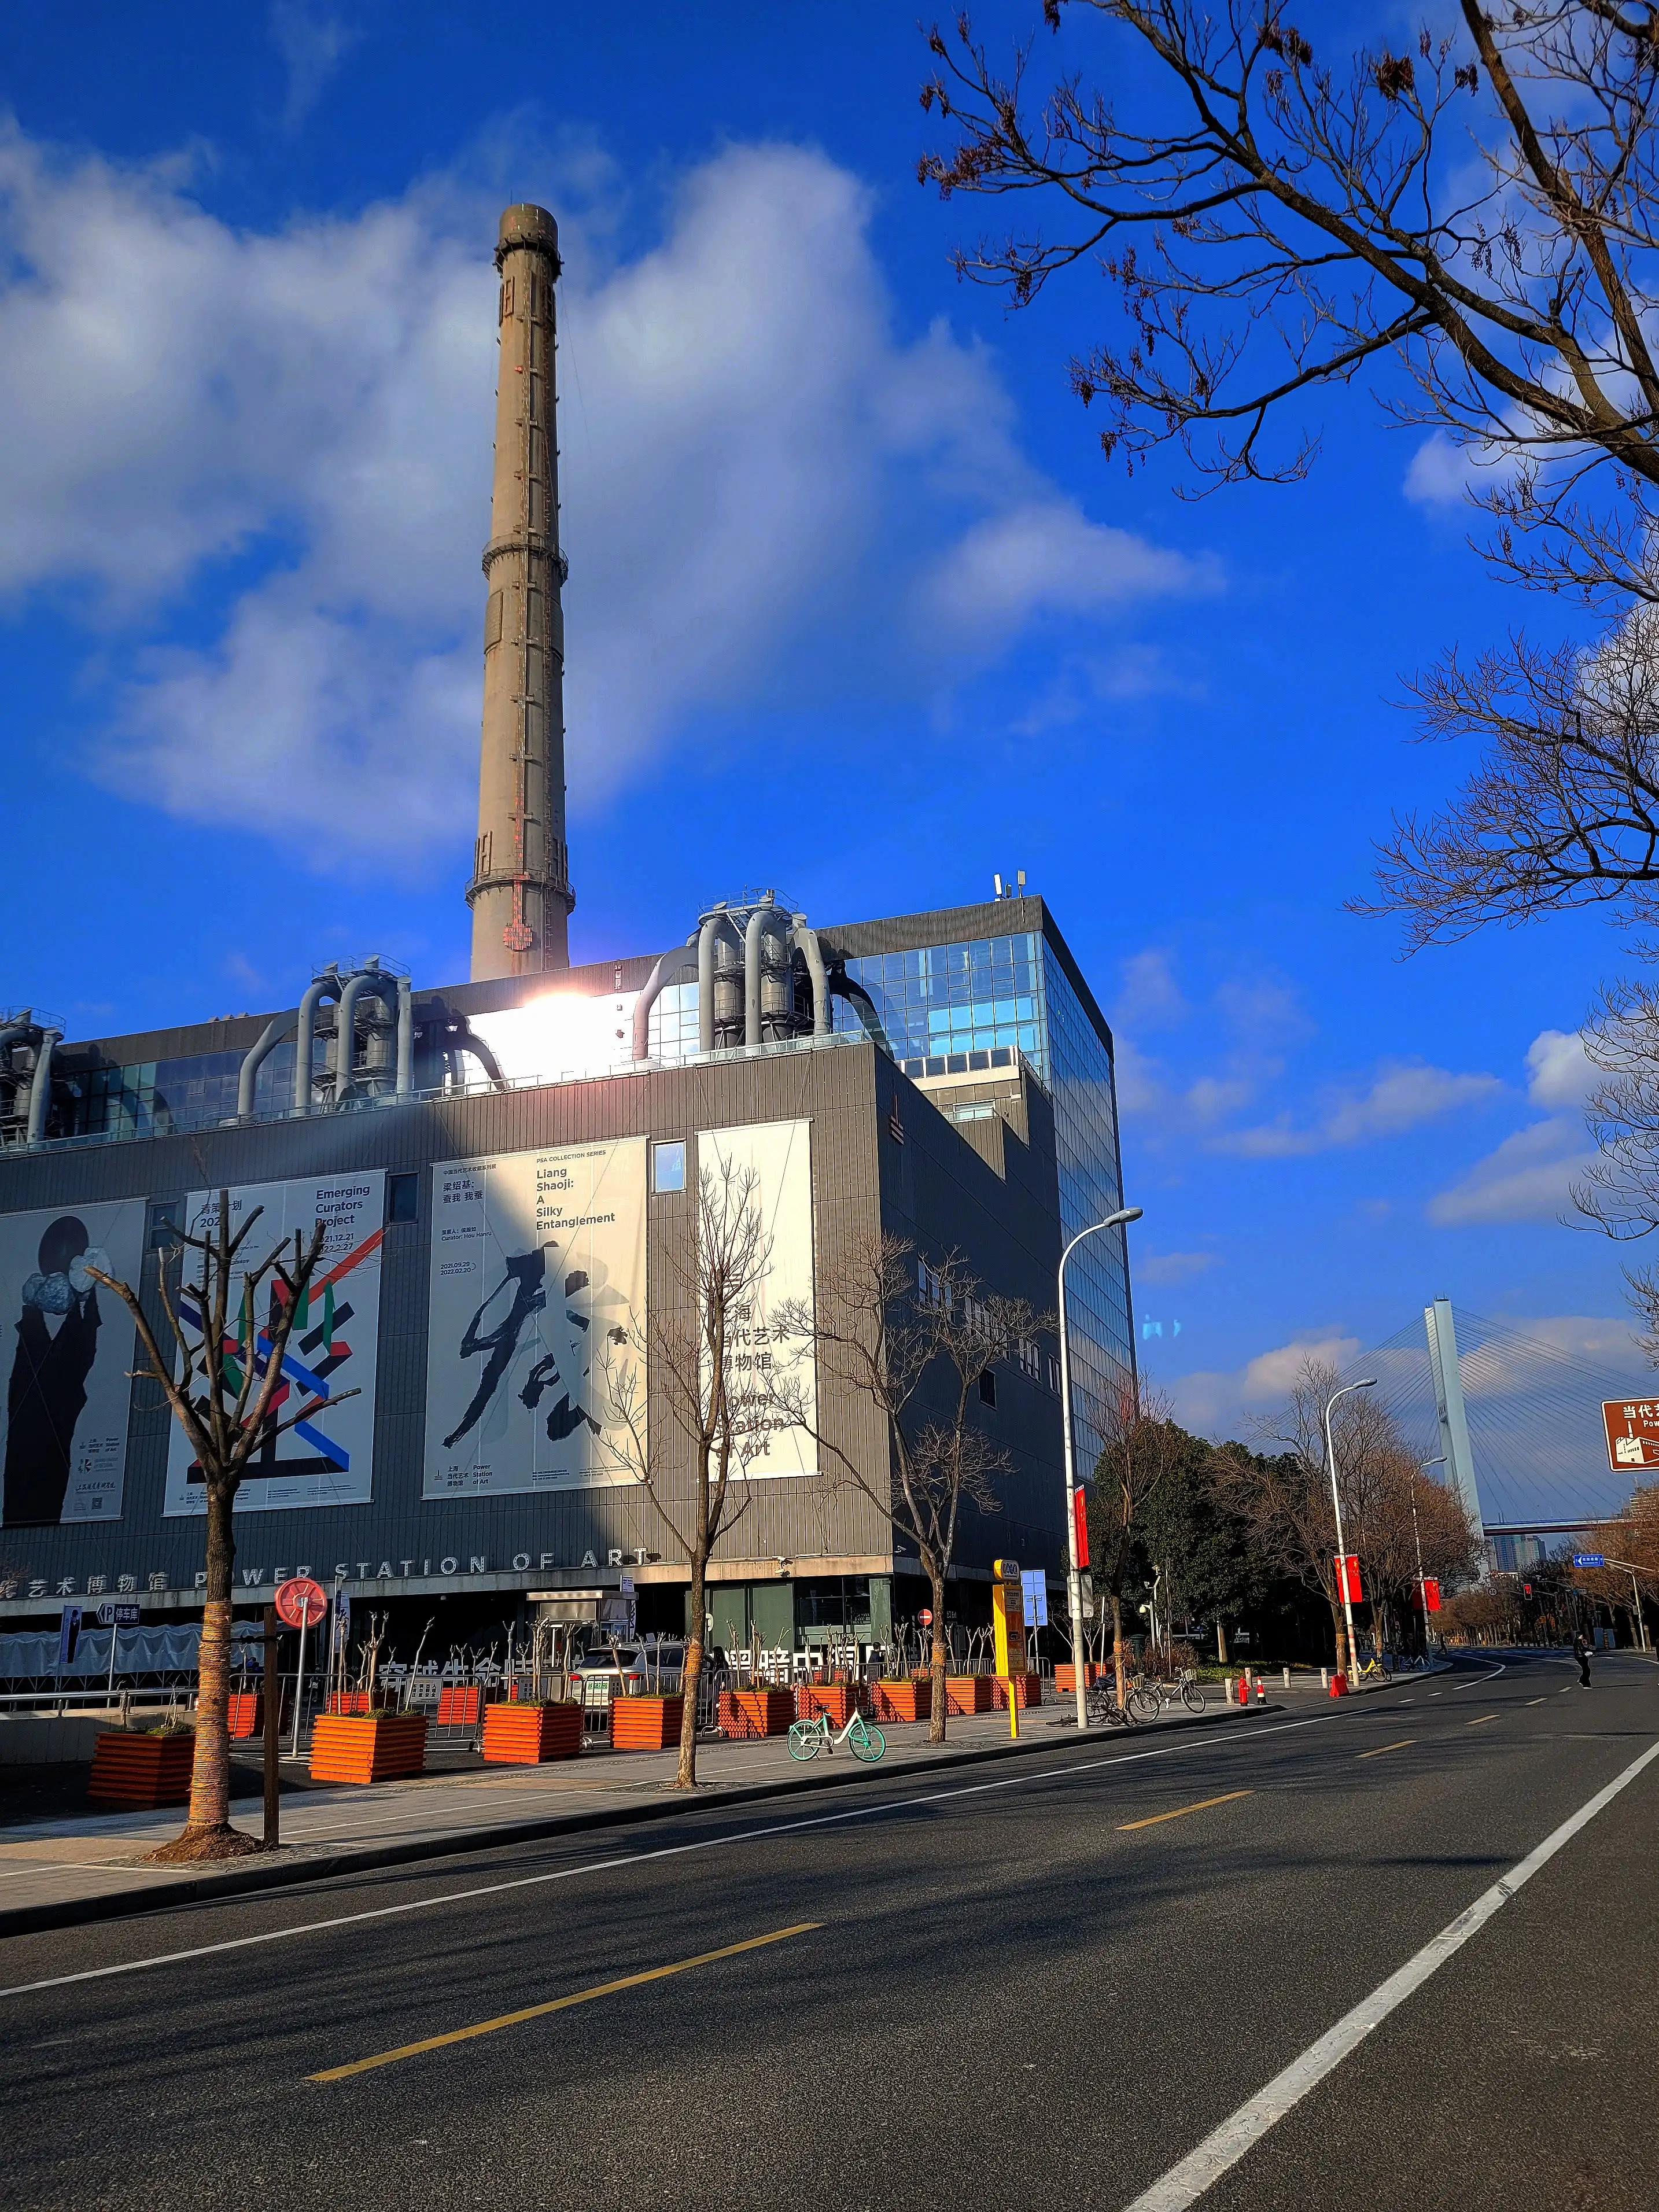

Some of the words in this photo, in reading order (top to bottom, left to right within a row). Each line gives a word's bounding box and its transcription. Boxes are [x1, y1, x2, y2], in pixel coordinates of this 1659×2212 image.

[549, 1153, 585, 1162] COLLECTION
[537, 1168, 567, 1179] Liang
[536, 1179, 574, 1192] Shaoji:
[316, 1185, 371, 1200] Emerging
[536, 1195, 545, 1204] A
[201, 1200, 242, 1214] 青策划
[315, 1201, 363, 1214] Curators
[536, 1207, 563, 1217] Silky
[200, 1216, 220, 1229] 202
[315, 1215, 355, 1228] Project
[536, 1212, 615, 1230] Entanglement
[440, 1261, 470, 1270] 2021.09.29
[440, 1267, 471, 1275] 2022.02.20
[728, 1392, 774, 1408] ower
[740, 1440, 770, 1458] Art
[195, 1565, 312, 1588] PWER
[336, 1555, 486, 1580] STATION
[513, 1552, 555, 1571] OF
[581, 1547, 647, 1569] ART
[106, 1606, 113, 1621] P
[116, 1608, 138, 1620] 停车库
